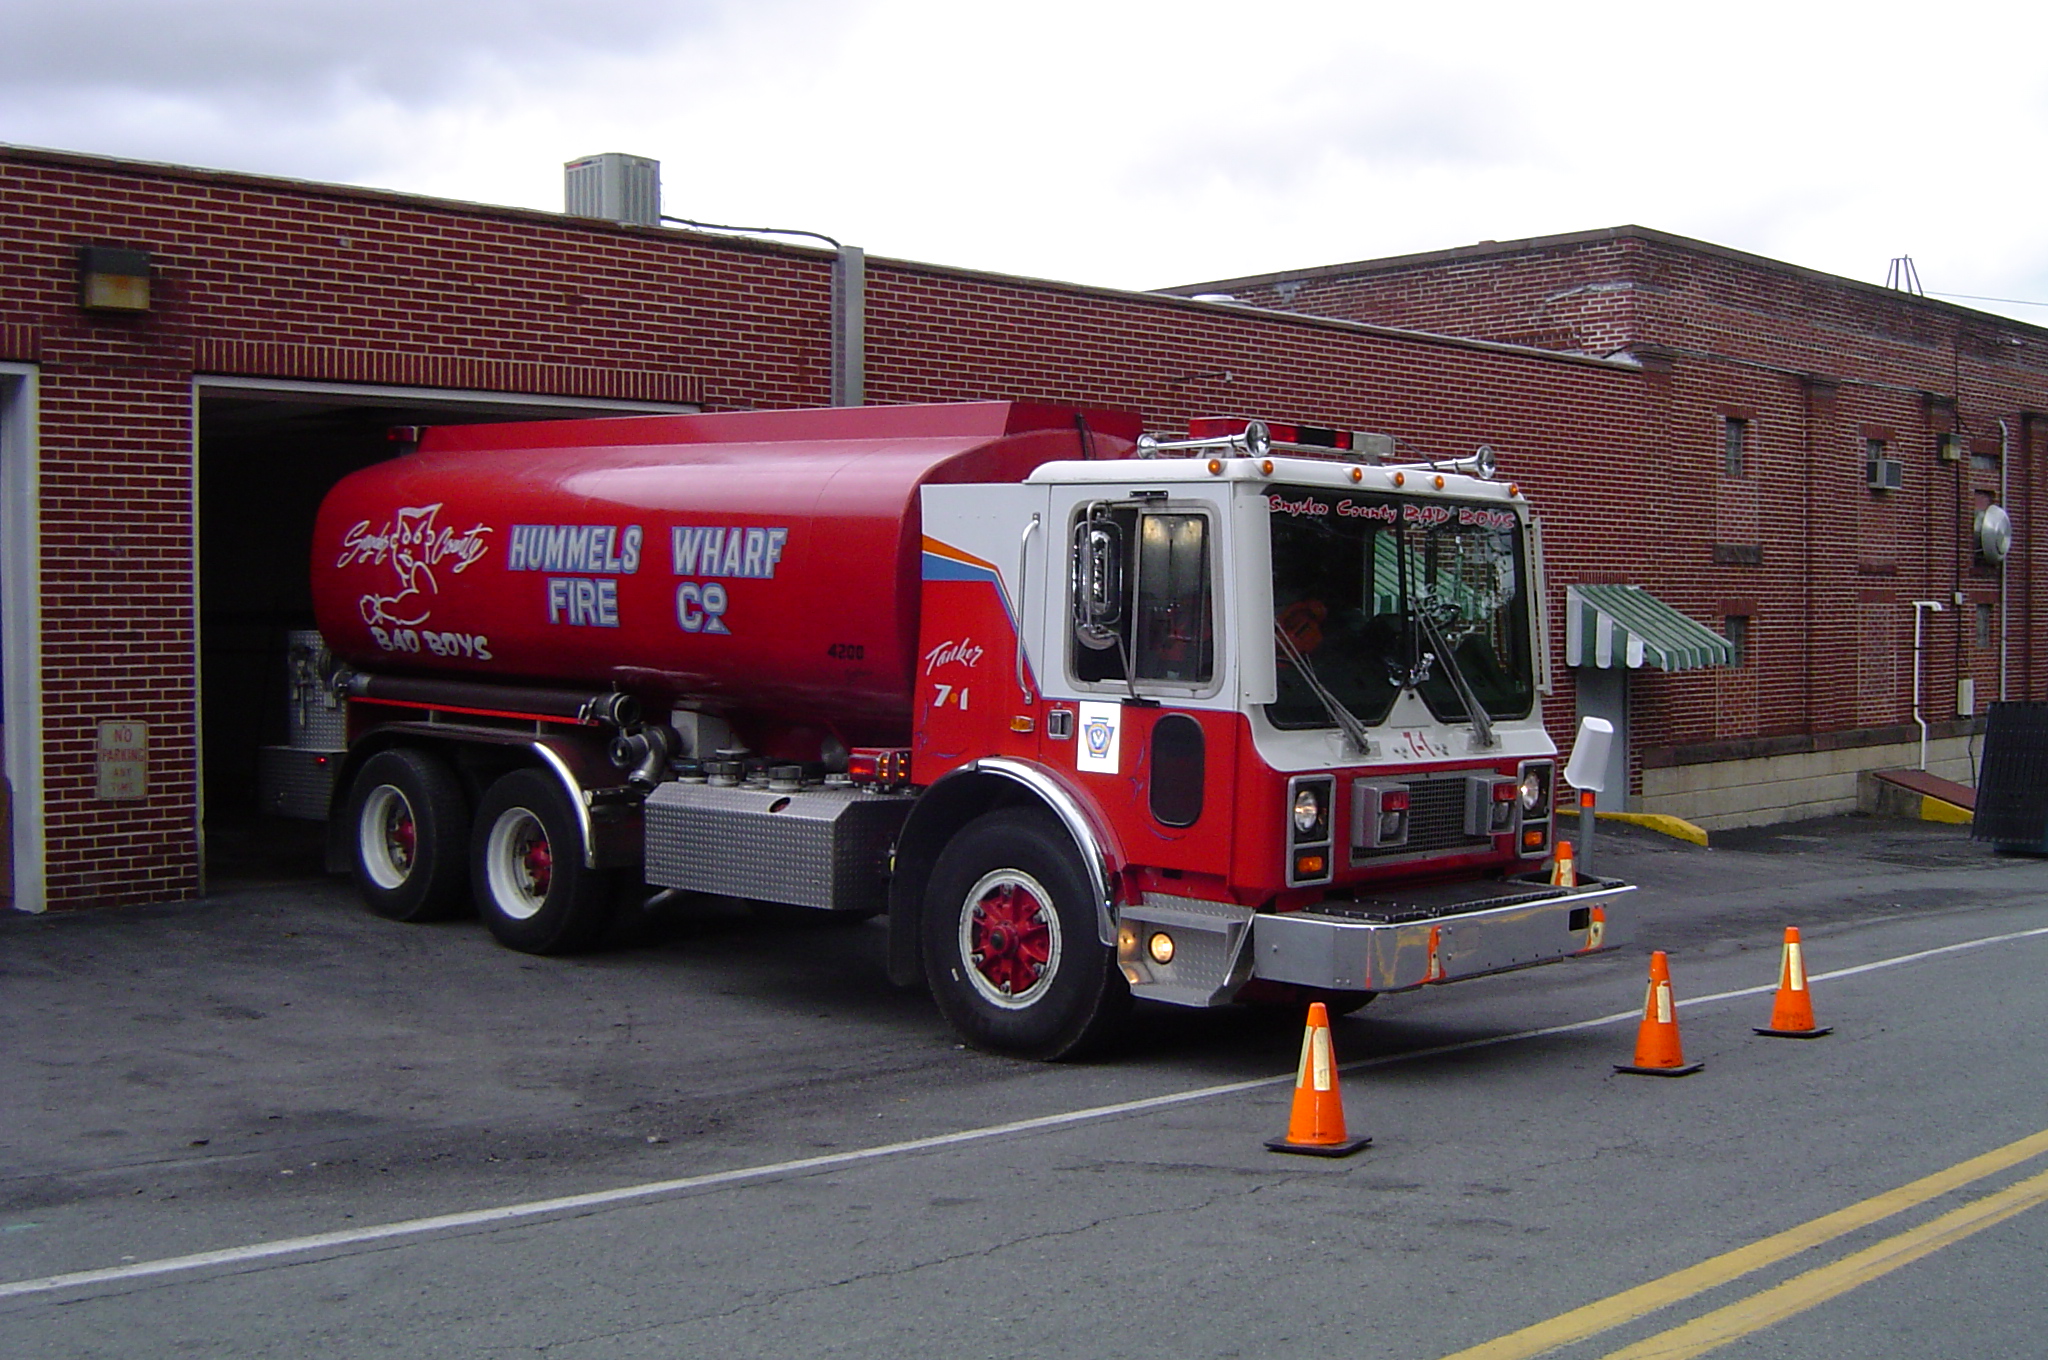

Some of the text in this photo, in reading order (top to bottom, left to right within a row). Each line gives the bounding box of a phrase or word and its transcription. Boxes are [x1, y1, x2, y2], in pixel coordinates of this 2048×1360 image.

[1270, 495, 1517, 529] Snyder County BAD BOYS
[508, 525, 788, 579] HUMMELS WHARF
[547, 577, 620, 627] FIRE
[370, 626, 493, 660] BAD BOYS
[827, 643, 865, 661] 4200
[925, 637, 983, 676] Tanker
[114, 729, 132, 742] NO
[102, 748, 145, 762] PARKING
[114, 768, 132, 777] ANY
